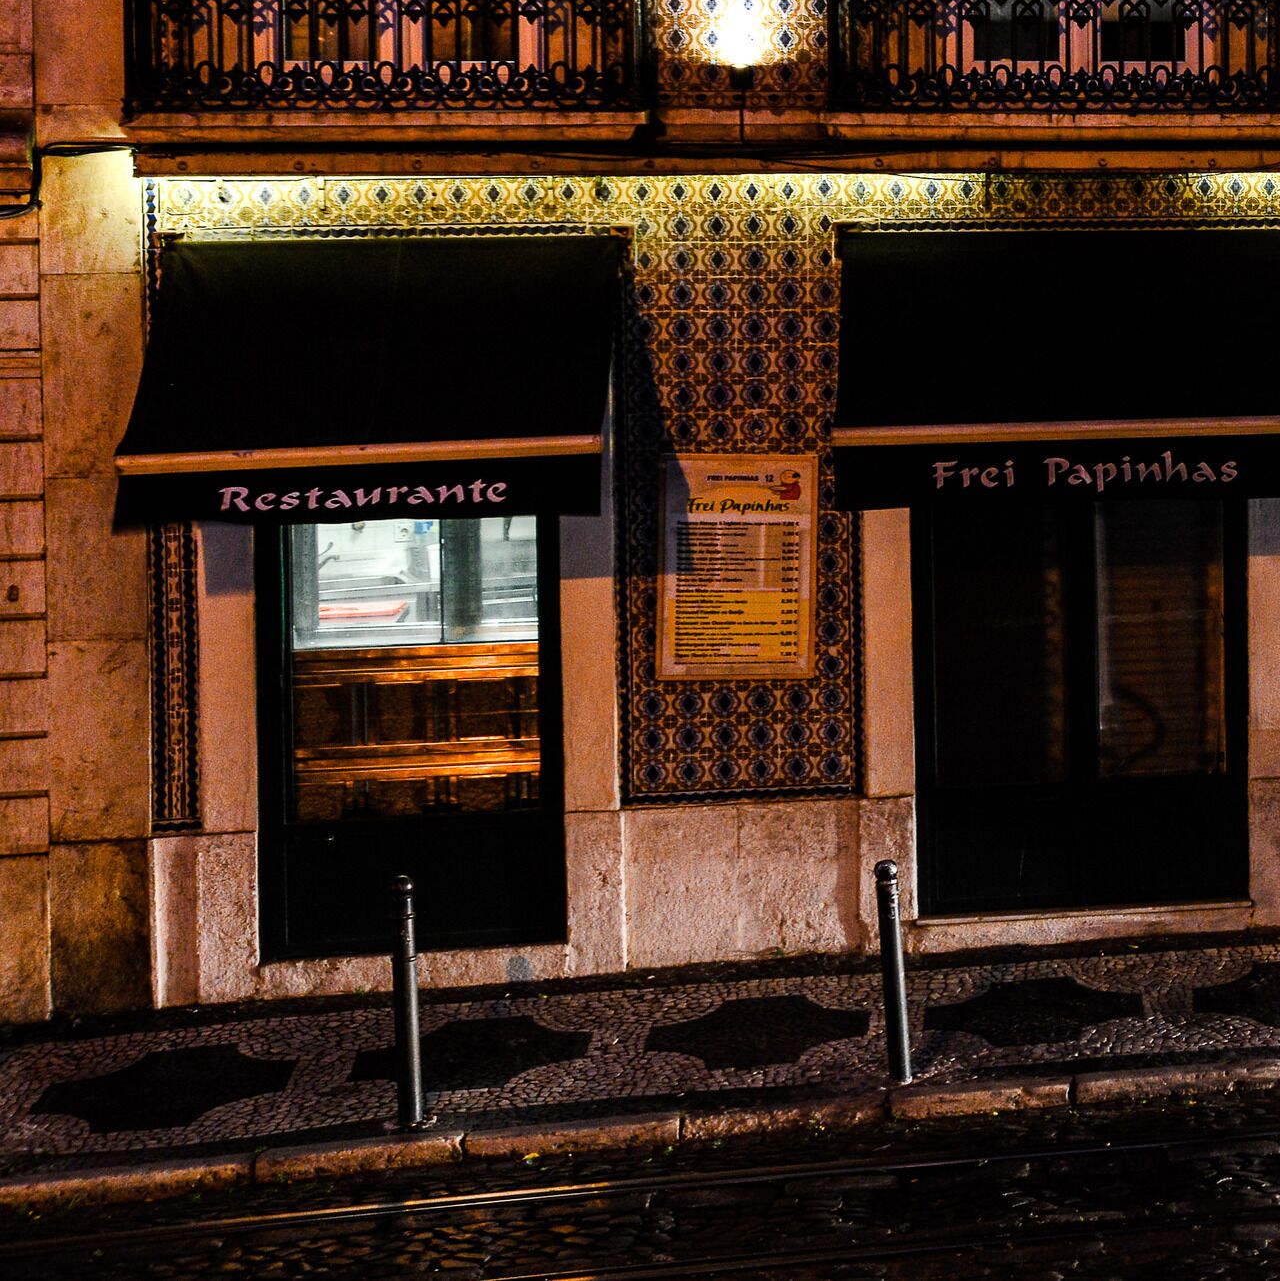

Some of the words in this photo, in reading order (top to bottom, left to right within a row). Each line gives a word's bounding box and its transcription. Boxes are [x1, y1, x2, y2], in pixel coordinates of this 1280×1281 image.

[932, 460, 1015, 489] Frei
[1043, 451, 1238, 492] Papinhas
[218, 479, 507, 512] Restaurante
[688, 497, 715, 513] Frei
[719, 498, 790, 515] Papinhas
